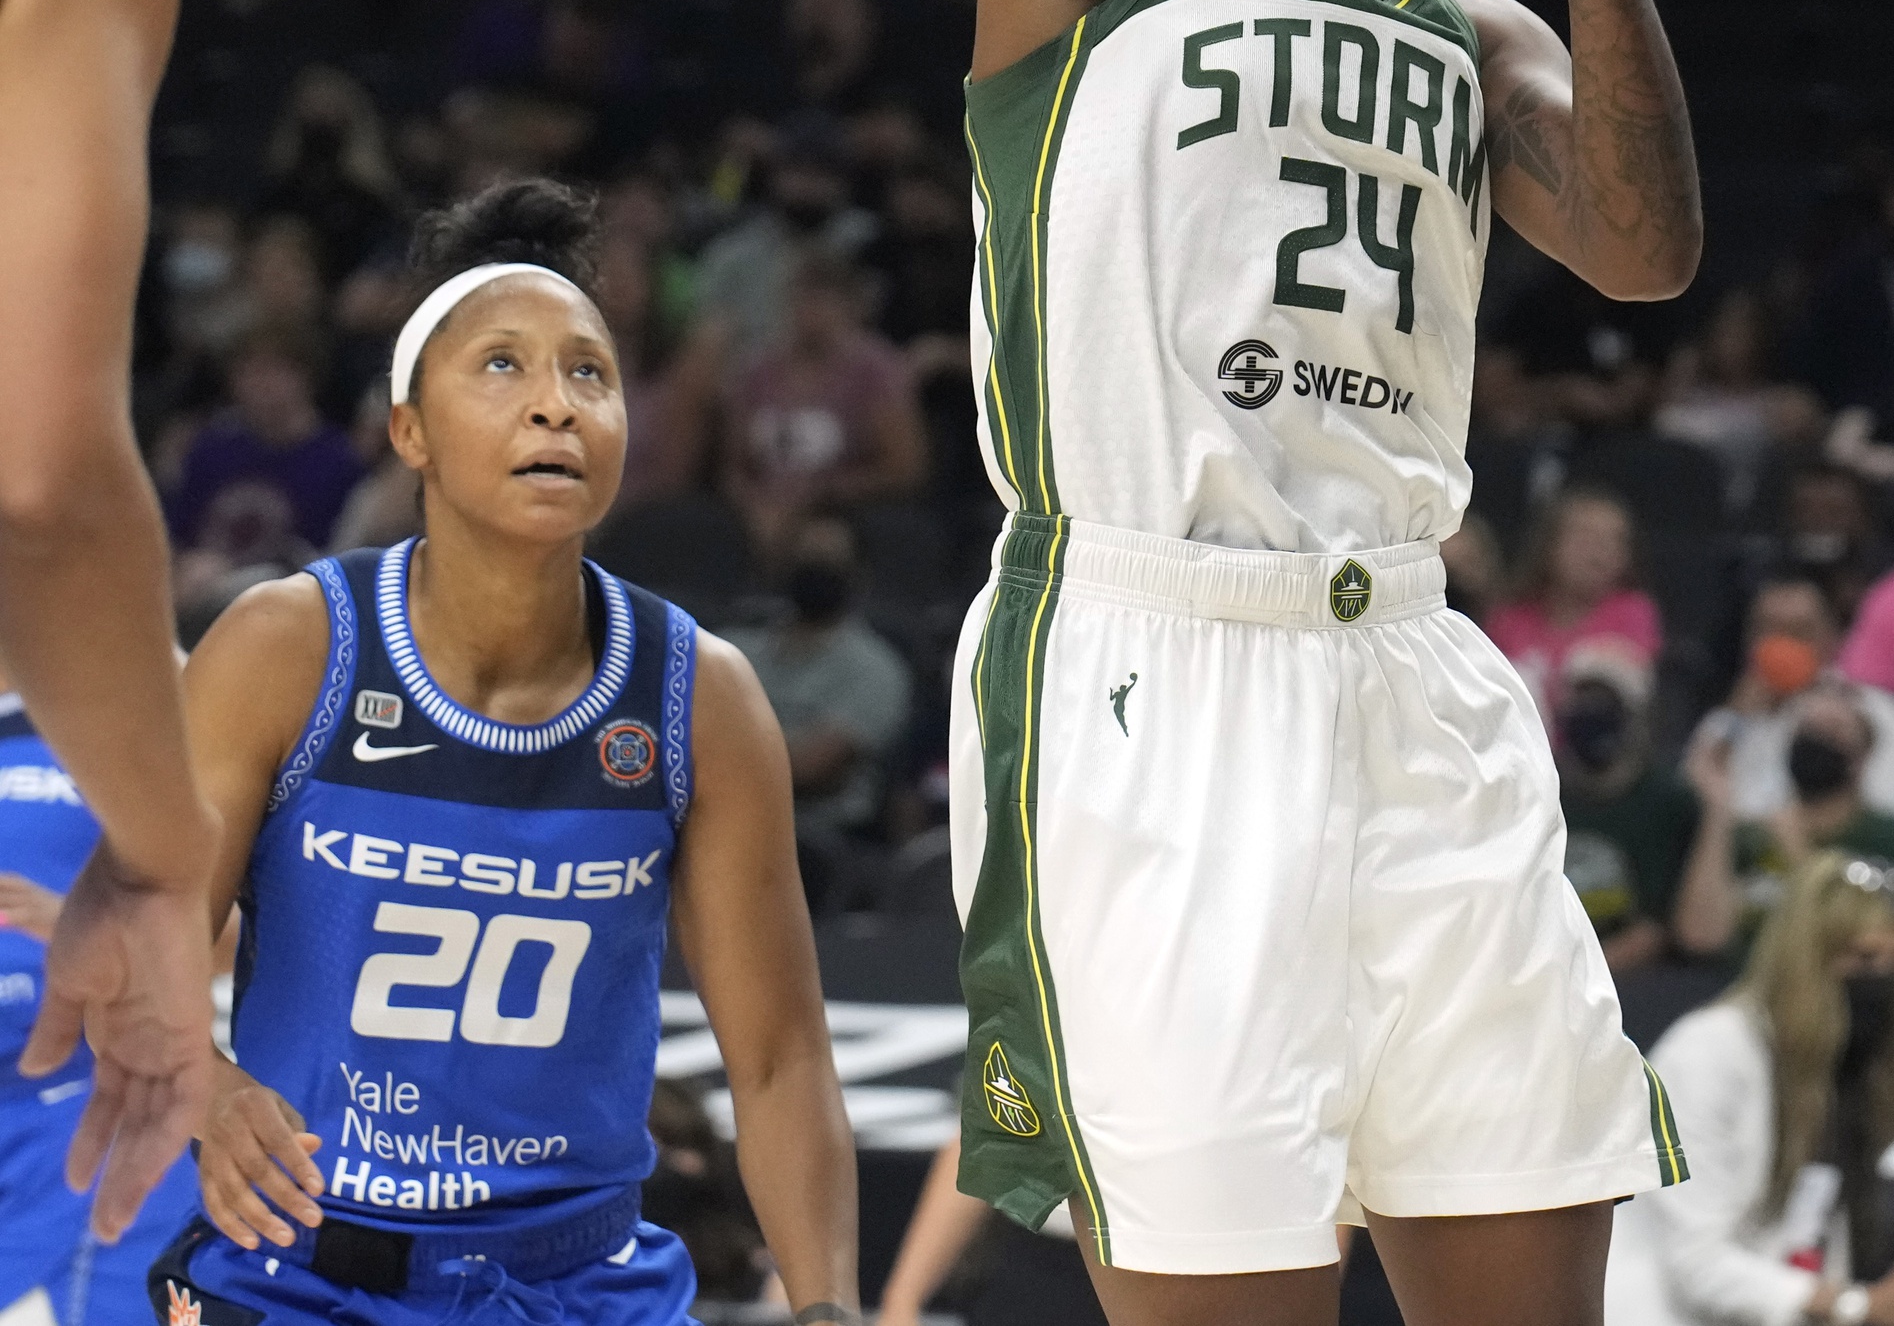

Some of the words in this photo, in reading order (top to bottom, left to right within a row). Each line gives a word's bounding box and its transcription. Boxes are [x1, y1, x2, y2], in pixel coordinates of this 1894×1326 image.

[1177, 17, 1486, 243] STORM
[1272, 155, 1423, 335] 24
[303, 821, 662, 900] KEESUSK
[350, 900, 593, 1048] 20
[340, 1061, 420, 1115] Yale
[340, 1106, 568, 1166] NewHaven
[331, 1156, 491, 1211] Health
